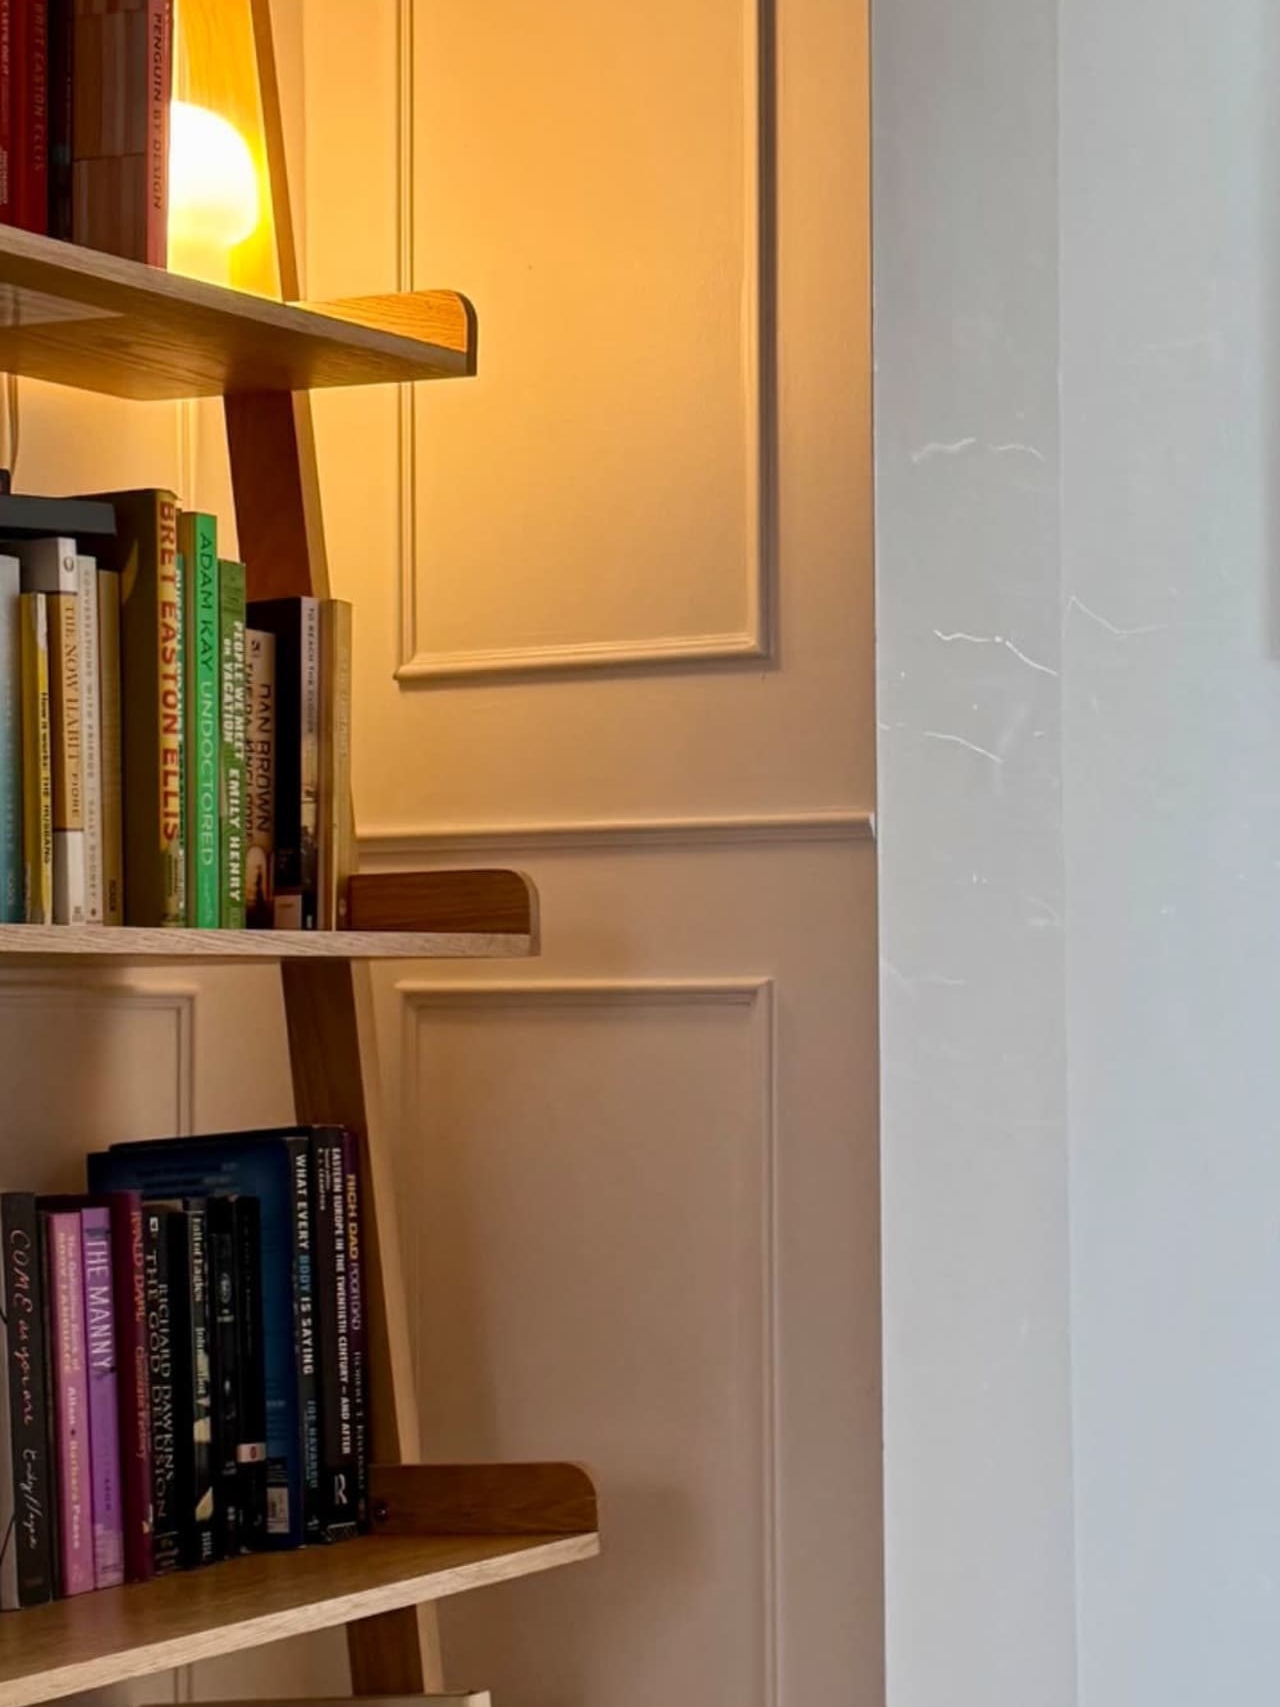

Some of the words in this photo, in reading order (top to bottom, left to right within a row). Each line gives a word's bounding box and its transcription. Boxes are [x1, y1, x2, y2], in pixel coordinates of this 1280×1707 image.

[159, 501, 176, 588] BRET
[198, 531, 213, 602] ADAM
[64, 606, 76, 639] THE
[199, 615, 214, 672] KAY
[64, 643, 80, 693] NOW
[160, 599, 179, 732] EASTON
[231, 620, 245, 682] PEOPLE
[39, 692, 50, 718] How
[223, 661, 234, 743] VACATION
[233, 685, 245, 712] WE
[257, 683, 272, 734] DAN
[66, 698, 81, 762] HABIT
[233, 715, 246, 762] MEET
[43, 775, 51, 799] THE
[70, 772, 80, 819] FIORE
[162, 746, 181, 842] ELLIS
[199, 680, 215, 867] UNDOCTORED
[227, 768, 241, 829] EMILY
[256, 740, 272, 834] BROWN
[227, 835, 242, 902] HENRY
[295, 1153, 309, 1198] WHAT
[297, 1200, 310, 1250] EVERY
[332, 1195, 343, 1235] EUROPE
[85, 1239, 111, 1282] THE
[145, 1250, 158, 1300] THE
[299, 1254, 312, 1293] BODY
[335, 1252, 345, 1272] THE
[87, 1285, 114, 1370] MANNY
[301, 1296, 312, 1313] IS
[148, 1310, 161, 1374] GOD
[156, 1284, 171, 1379] RICHARD
[301, 1317, 314, 1376] SAYING
[338, 1336, 349, 1383] CENTURY
[161, 1385, 175, 1482] DAWKINS
[341, 1396, 351, 1420] AND
[151, 1385, 168, 1519] DELUSION
[342, 1423, 352, 1455] AFTER
